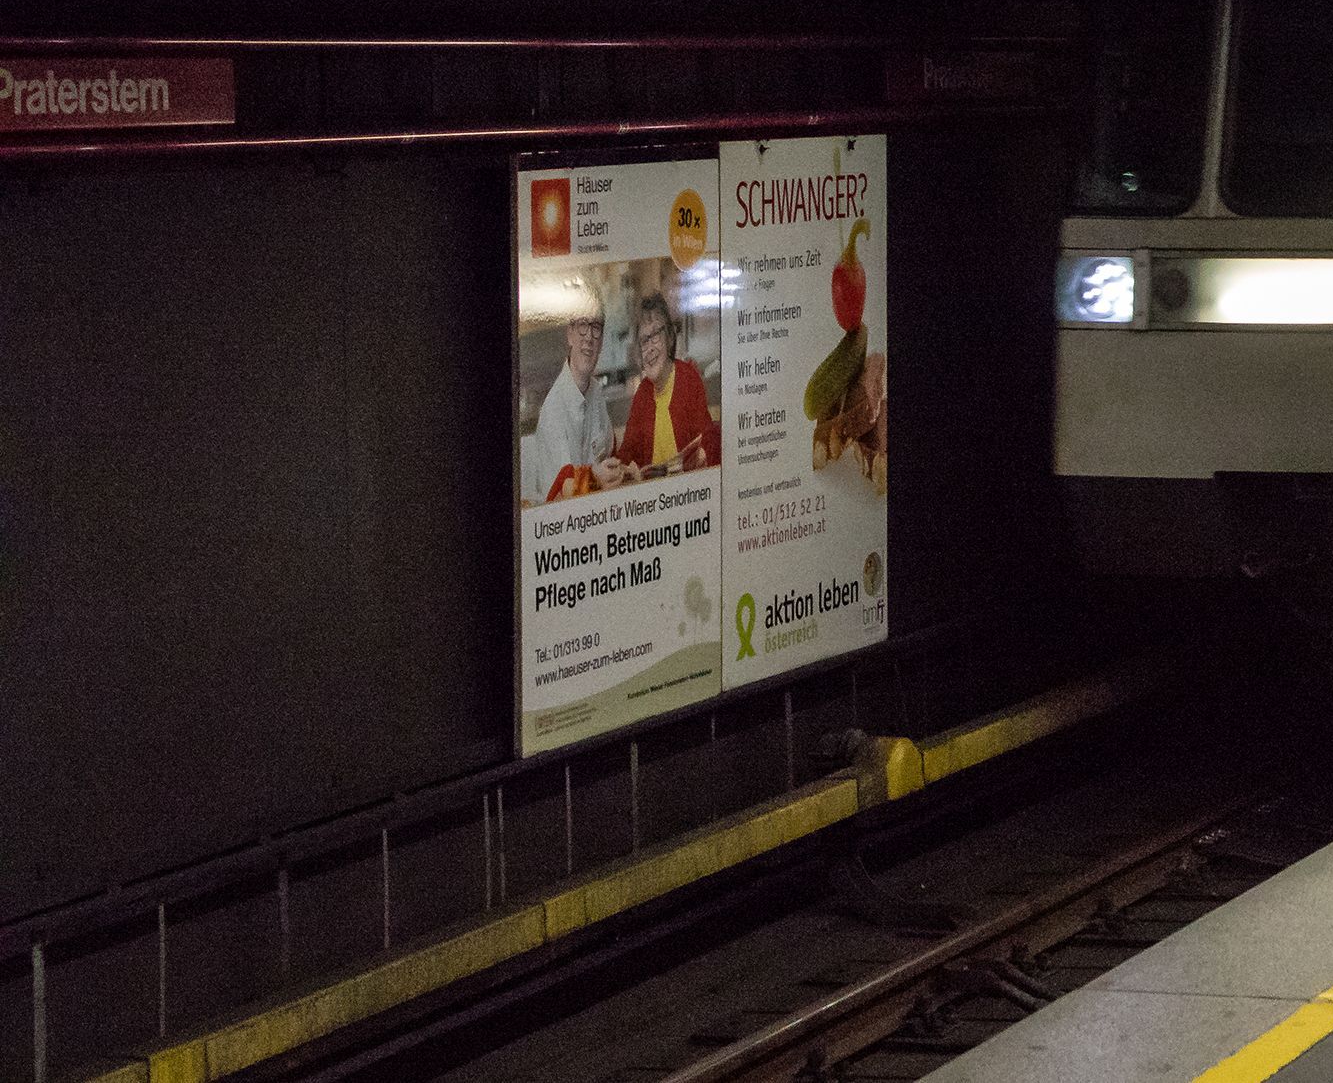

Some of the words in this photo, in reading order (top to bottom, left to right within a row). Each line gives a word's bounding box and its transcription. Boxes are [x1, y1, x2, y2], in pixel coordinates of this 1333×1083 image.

[577, 176, 613, 194] Häuser
[736, 173, 867, 228] SCHWANGER?
[577, 201, 599, 216] zum
[678, 207, 693, 228] 30
[577, 220, 609, 237] Leben
[754, 255, 787, 273] nehmen
[789, 254, 803, 269] uns
[805, 248, 822, 267] Zeit
[737, 309, 752, 326] Wir
[754, 303, 802, 324] informieren
[737, 360, 752, 378] Wir
[754, 356, 781, 376] helfen
[738, 412, 752, 430] Wir
[754, 408, 786, 428] beraten
[534, 518, 564, 539] Unser
[566, 508, 607, 533] Angebot
[610, 505, 622, 521] für
[624, 497, 658, 518] Wiener
[659, 487, 711, 511] SeniorInnen
[738, 511, 758, 531] tel.:
[762, 501, 796, 527] 01/512
[800, 498, 811, 516] 52
[815, 495, 826, 512] 21
[534, 542, 603, 576] Wohnen,
[607, 523, 681, 559] Betreuung
[685, 511, 711, 539] und
[738, 517, 826, 554] www.aktionleben.at
[535, 581, 586, 612] Pflege
[590, 567, 626, 598] nach
[630, 556, 662, 587] Maß
[765, 589, 814, 629] aktion
[818, 578, 859, 614] leben
[553, 638, 581, 660] 01/313
[581, 635, 593, 651] 99
[593, 632, 600, 647] 0
[764, 620, 818, 654] österreich
[535, 642, 654, 687] www.haeuser-zum-leben.com
